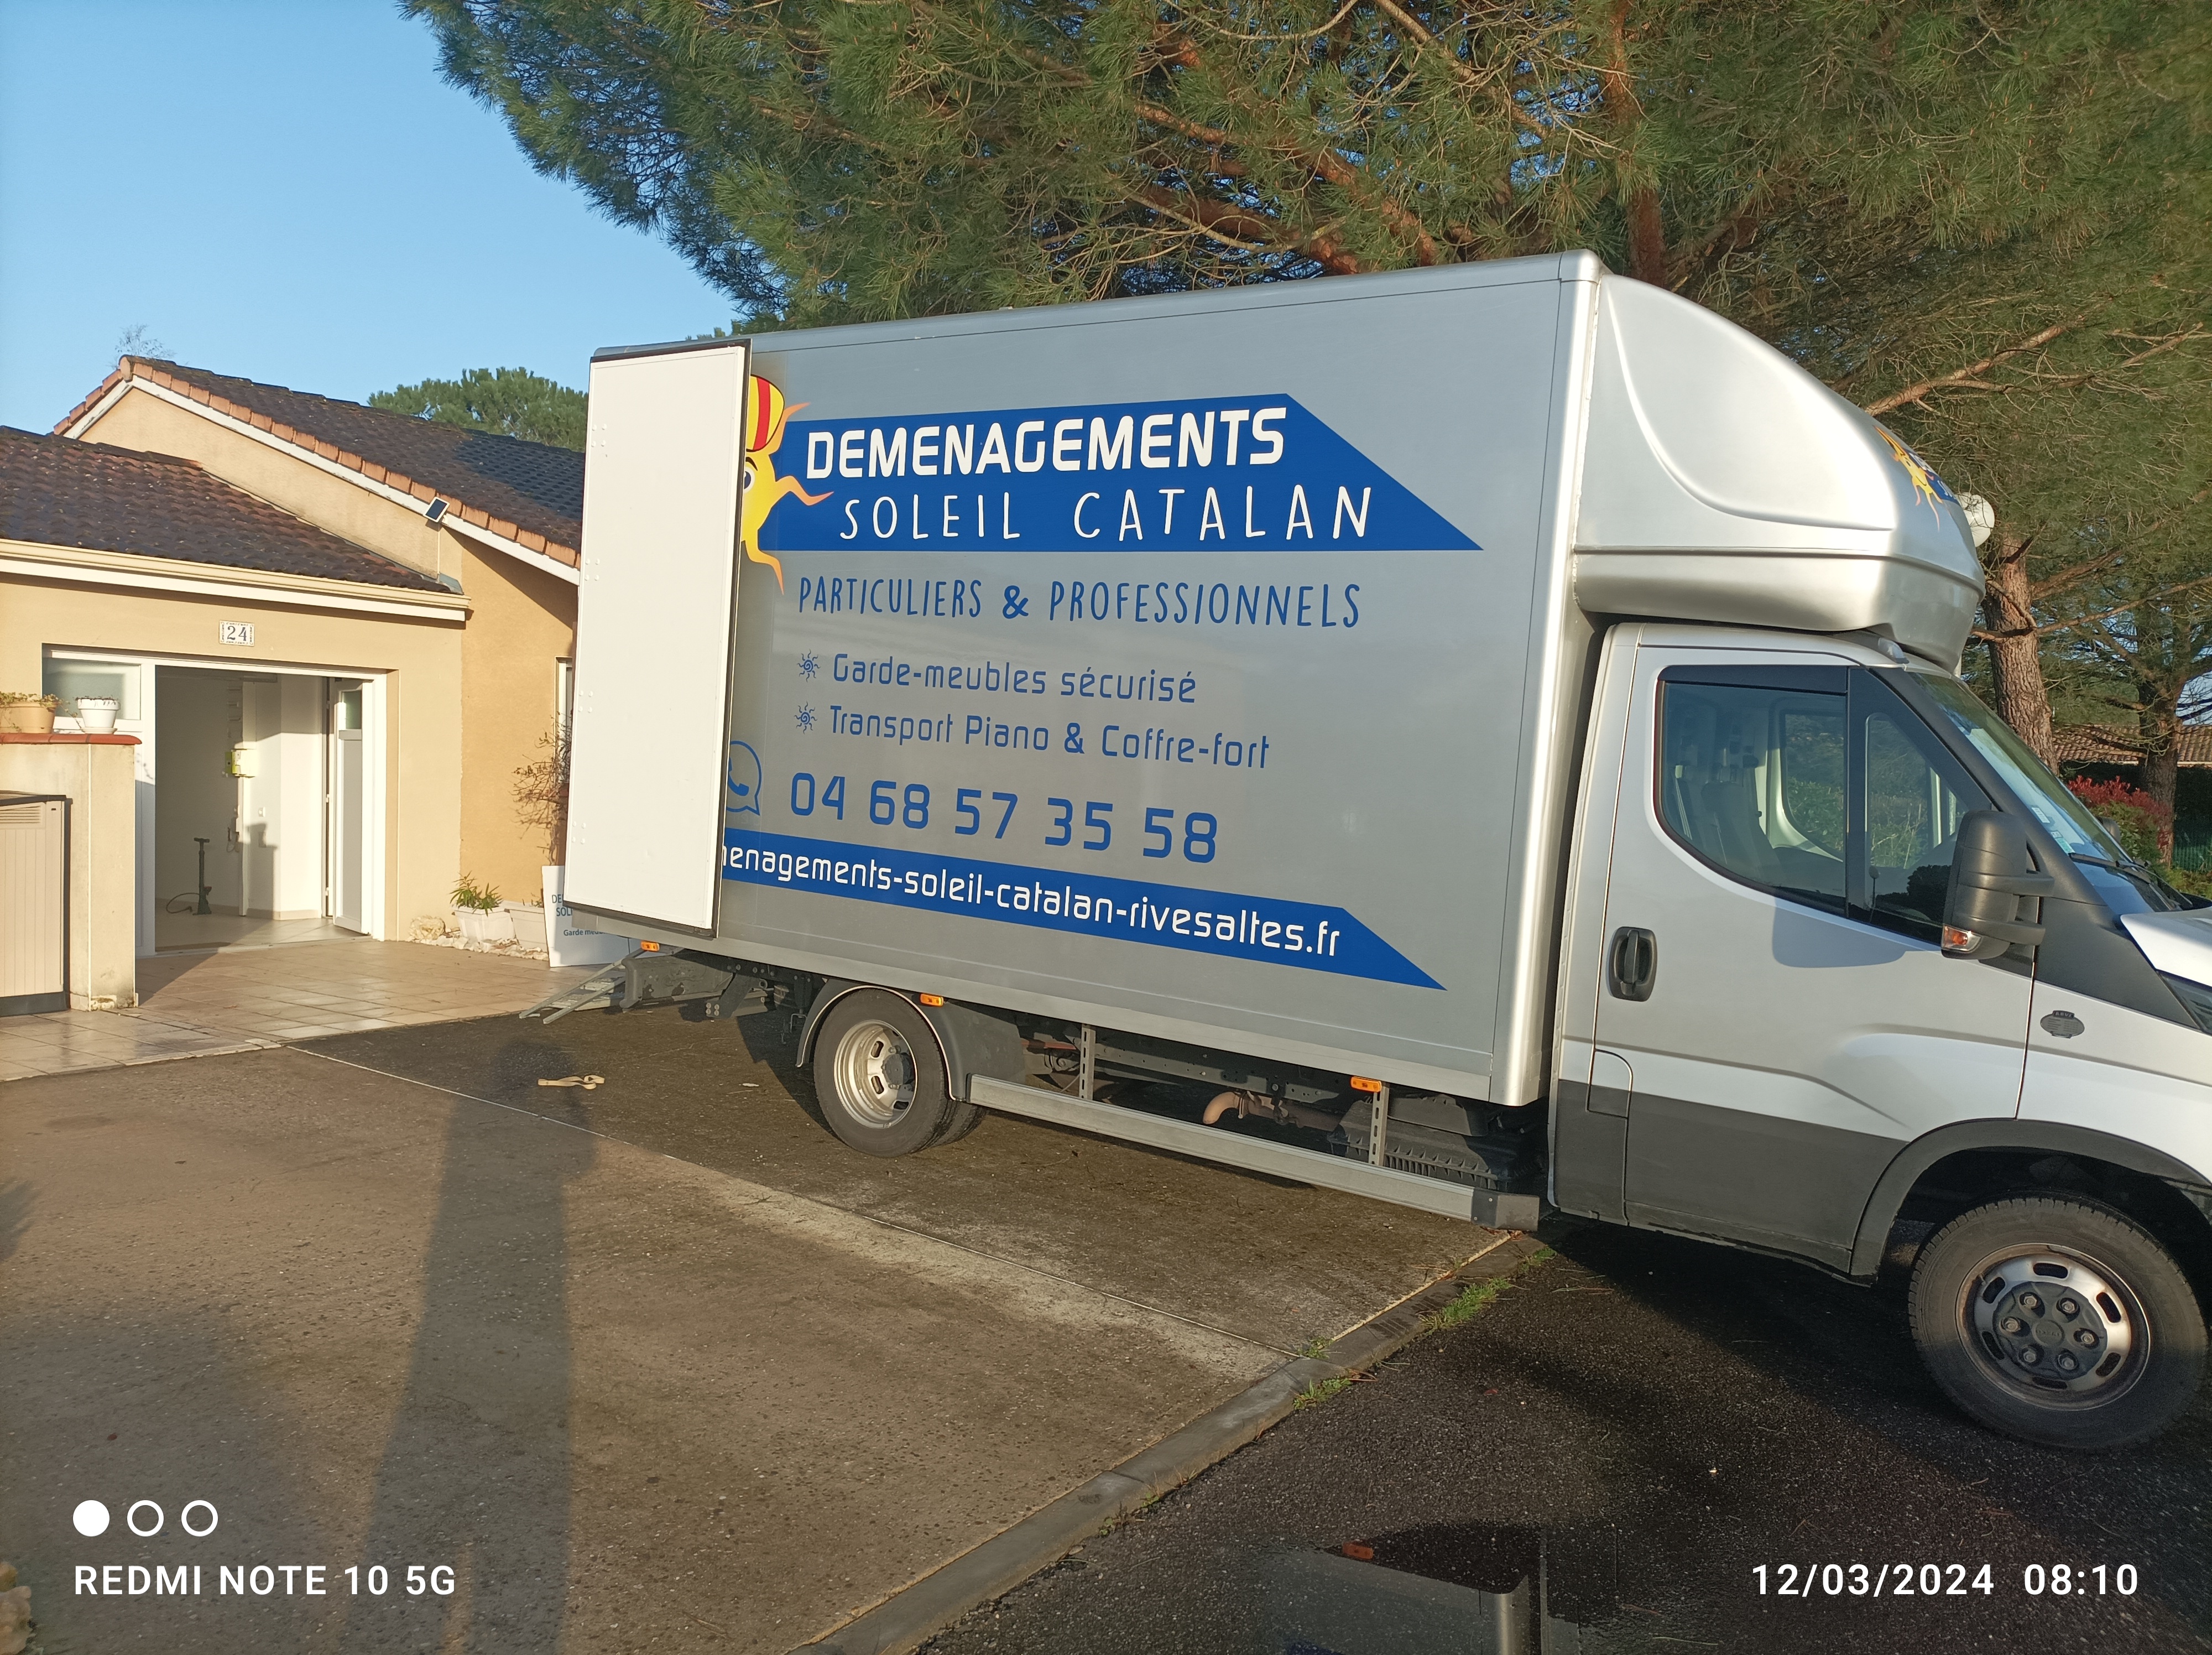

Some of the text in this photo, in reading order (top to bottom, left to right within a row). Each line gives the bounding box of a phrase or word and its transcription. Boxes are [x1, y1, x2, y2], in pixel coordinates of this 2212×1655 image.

[807, 408, 1286, 478] DEMENAGEMENTS
[841, 485, 1370, 541] SOLEIL CATALAN
[799, 576, 1360, 628] PARTICULIERS & PROFESSIONNELS
[227, 625, 247, 642] 24
[833, 654, 1196, 703] Garde-meubles sécurisé
[830, 705, 1270, 768] Transport Piano & Coffre-fort
[791, 773, 1217, 863] 04 68 57 35 58
[551, 894, 563, 903] DE
